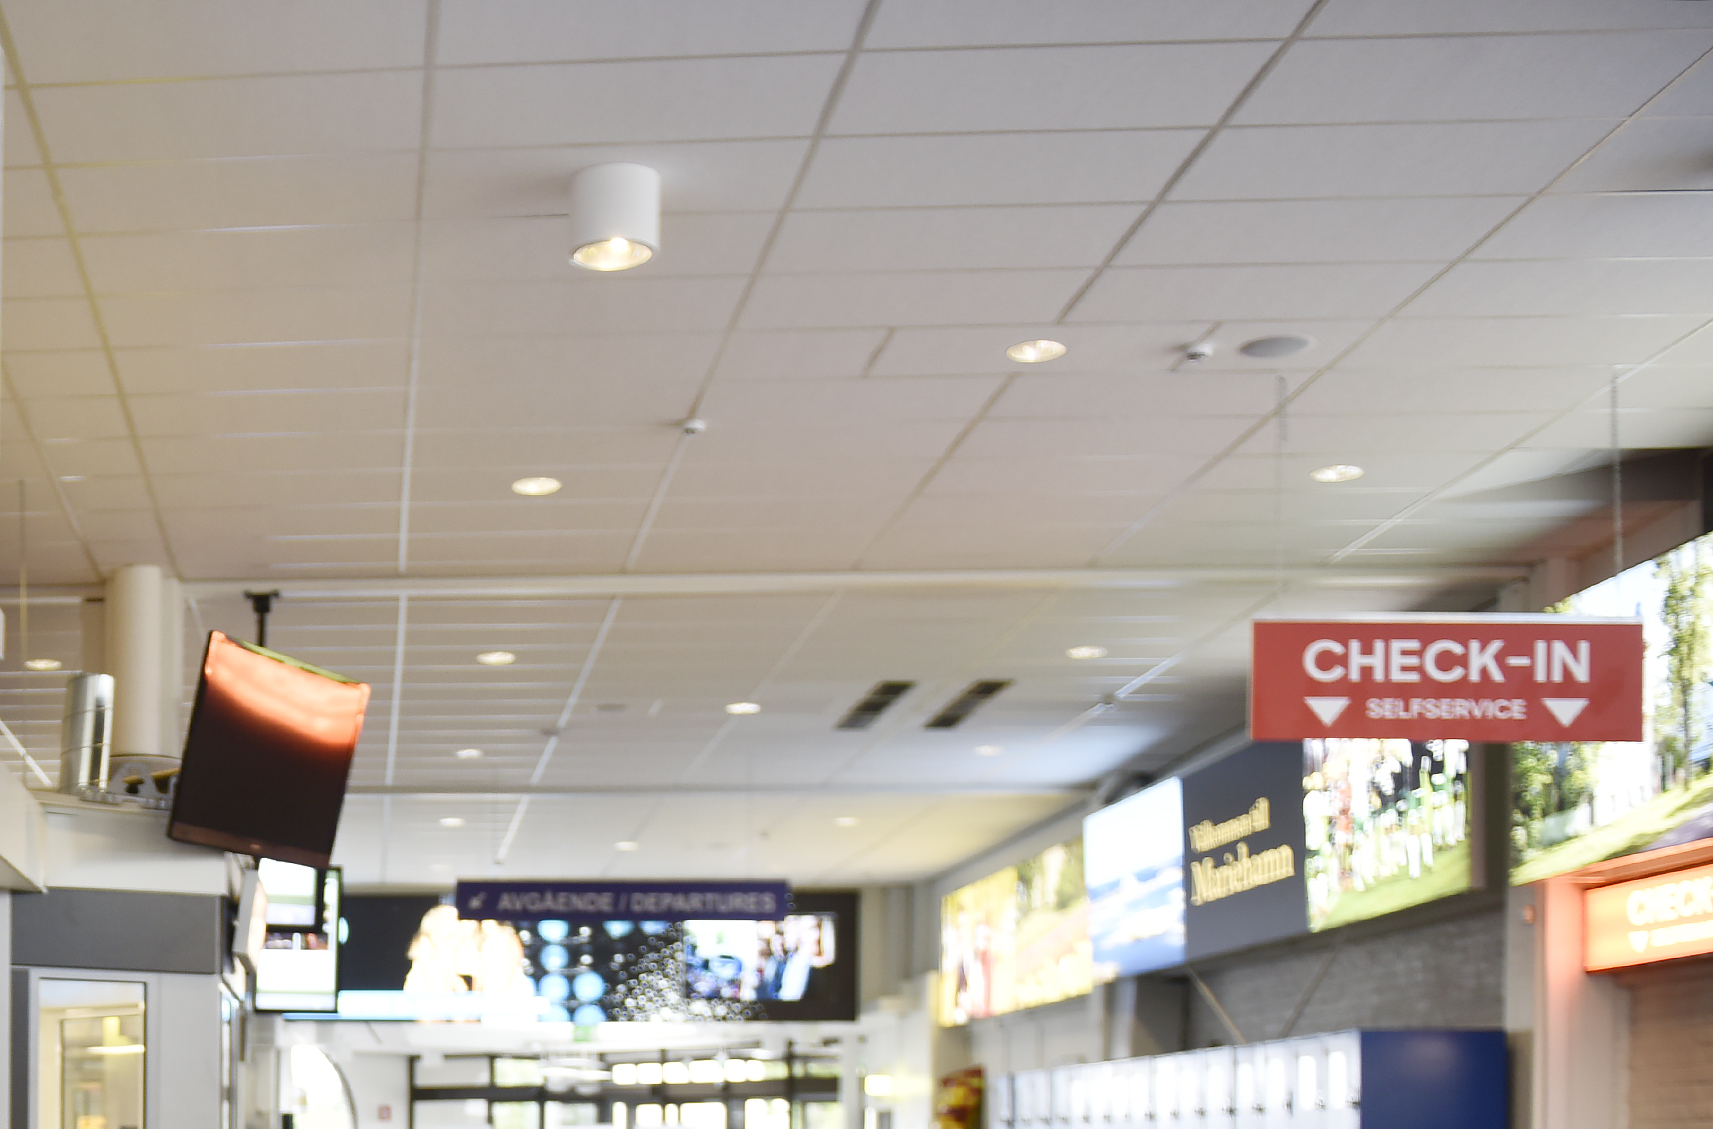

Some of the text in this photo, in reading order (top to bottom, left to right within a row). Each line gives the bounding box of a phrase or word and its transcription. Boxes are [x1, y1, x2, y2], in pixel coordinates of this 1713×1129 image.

[1302, 639, 1590, 683] CHECK-IN
[1366, 698, 1527, 720] SELFSERVICE
[497, 889, 614, 913] AVGÅENDE
[630, 891, 777, 914] DEPARTURES
